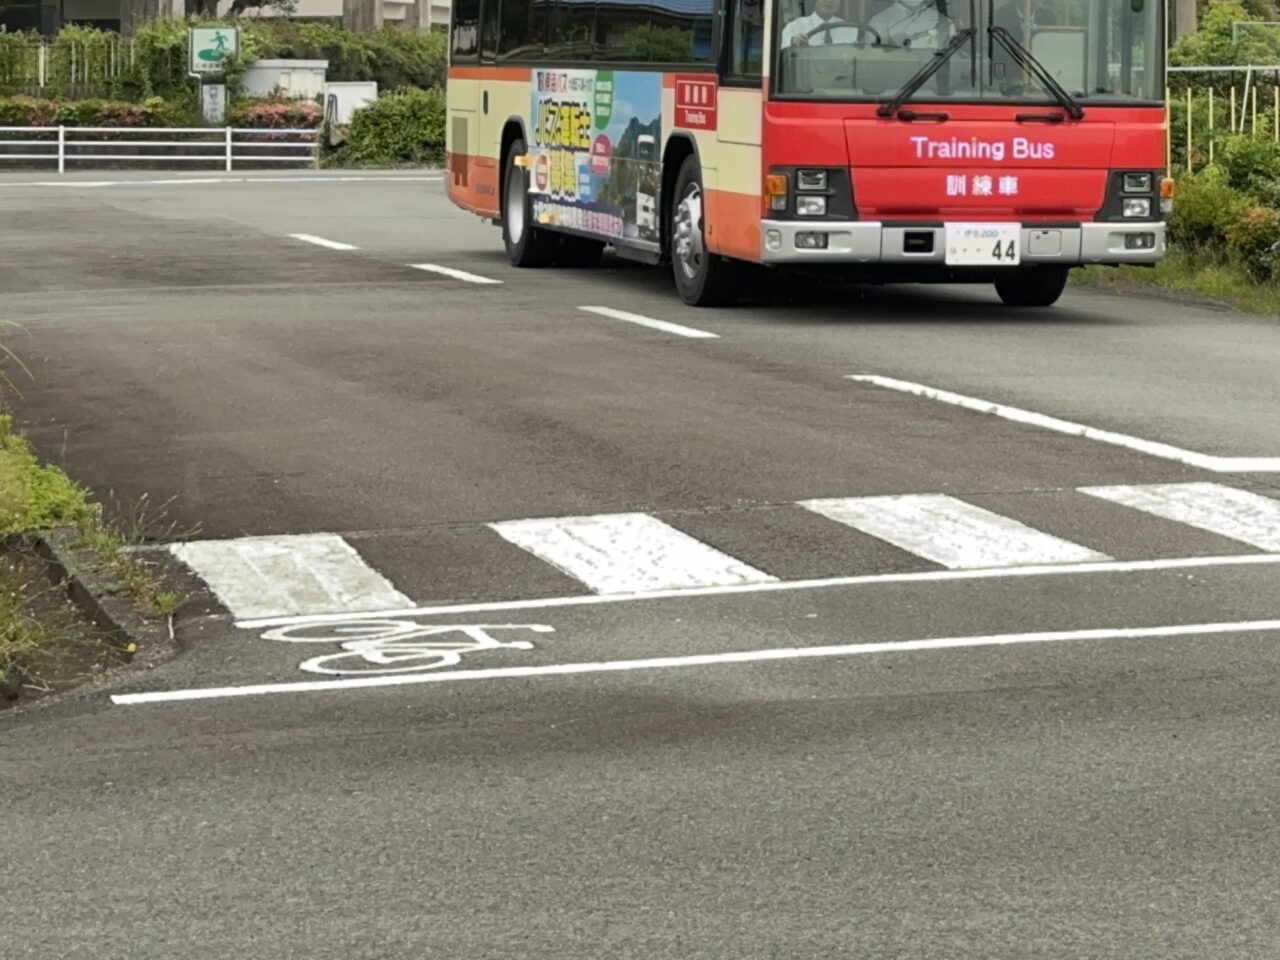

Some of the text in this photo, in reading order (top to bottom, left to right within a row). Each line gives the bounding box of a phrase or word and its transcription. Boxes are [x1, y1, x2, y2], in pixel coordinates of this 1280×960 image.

[910, 136, 1055, 160] Training Bus
[946, 175, 1018, 196] 訓練車
[992, 239, 1015, 260] 44
